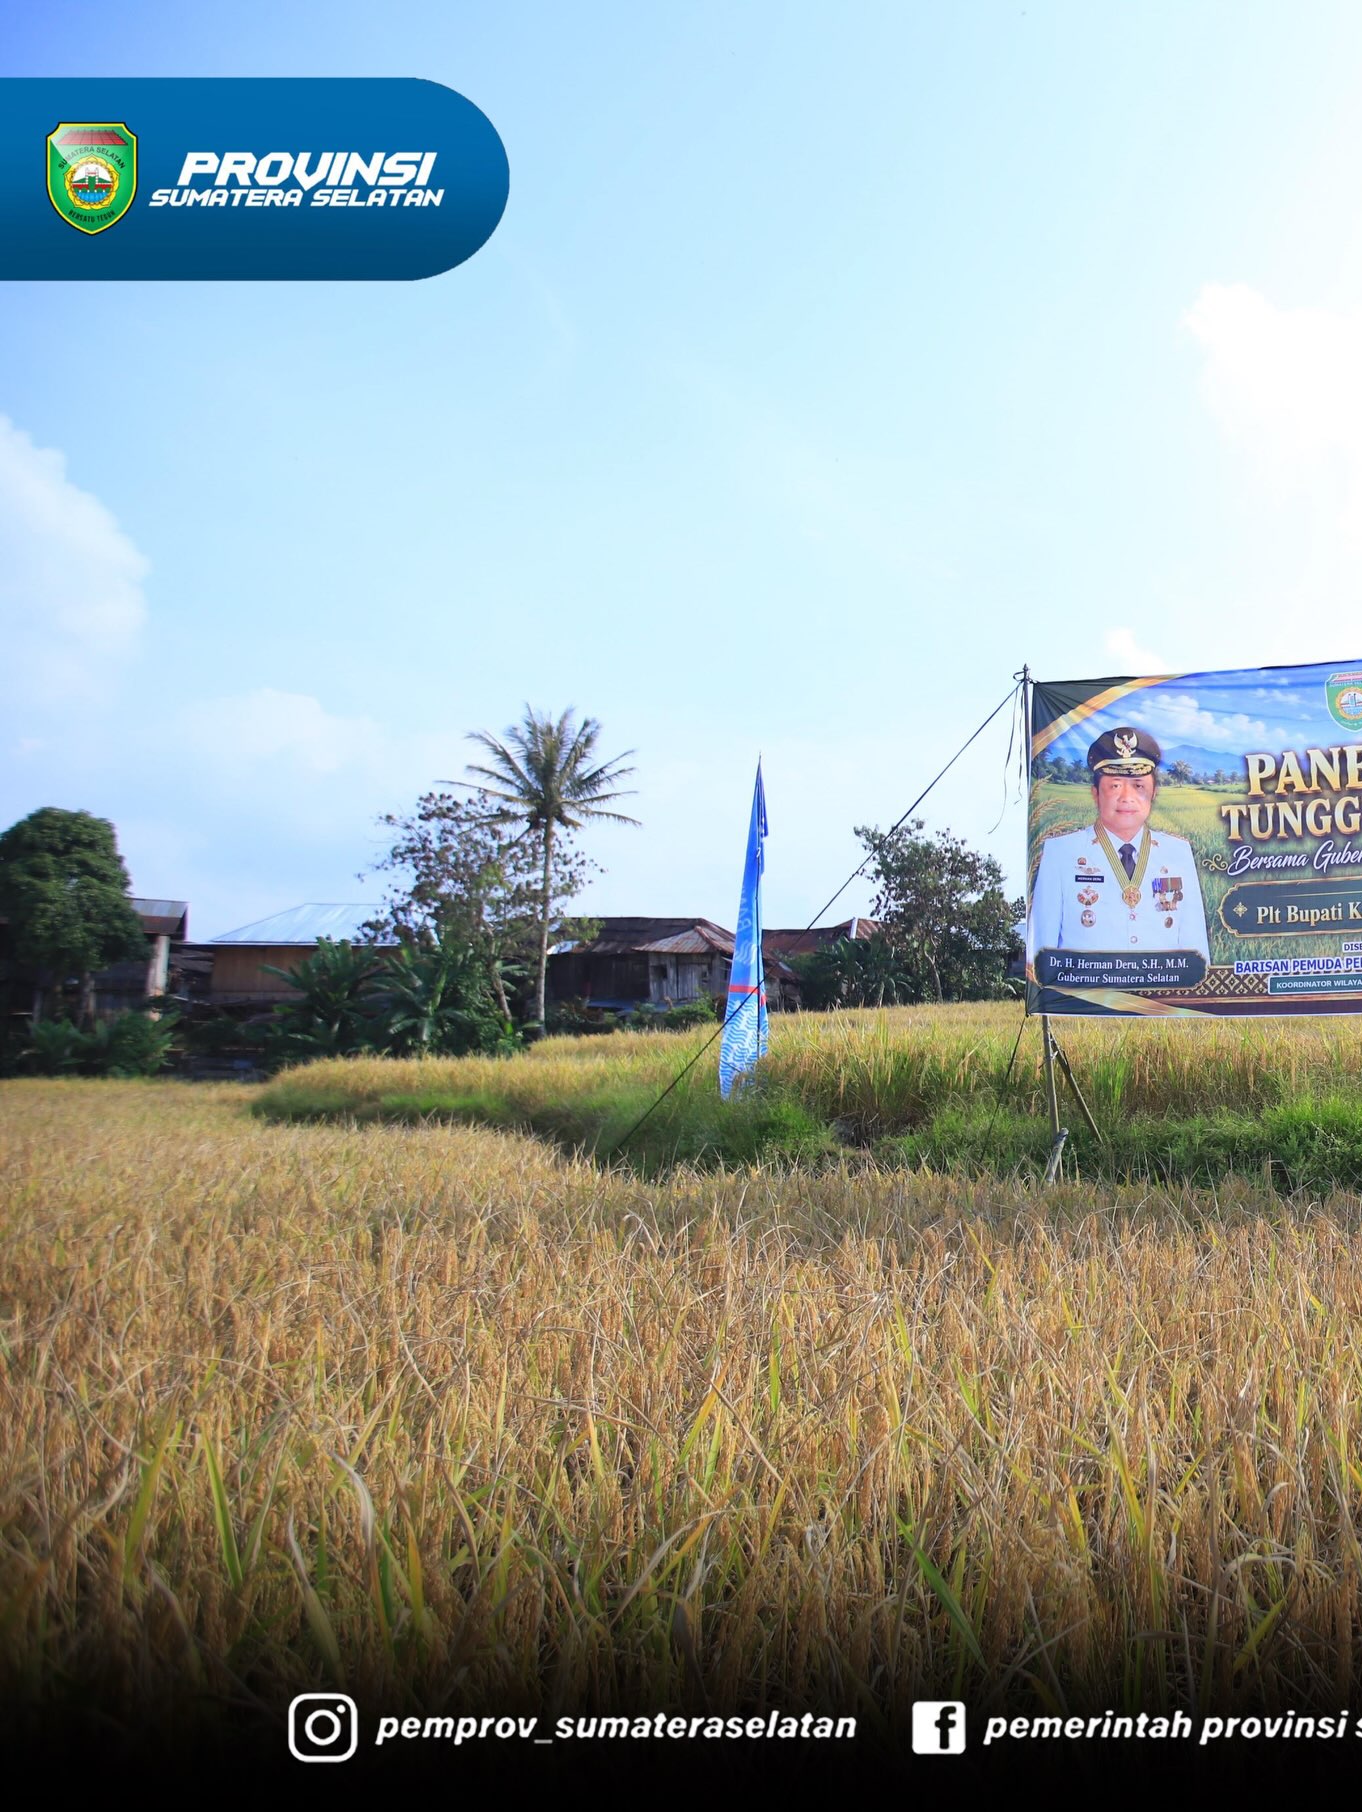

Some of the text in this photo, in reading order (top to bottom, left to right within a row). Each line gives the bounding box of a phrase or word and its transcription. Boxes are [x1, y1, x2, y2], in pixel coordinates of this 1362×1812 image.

[1226, 846, 1309, 876] Bersama
[1256, 905, 1281, 925] Plt
[1287, 902, 1342, 927] Bupati
[1050, 956, 1189, 970] Dr. H. Herman Deru, S.H., M.M.
[1236, 960, 1289, 974] BARISAN
[1292, 958, 1342, 972] PEMUDA
[1057, 972, 1180, 984] Gubernur Sumatera Selatan
[1276, 980, 1332, 989] KOORDINATOR
